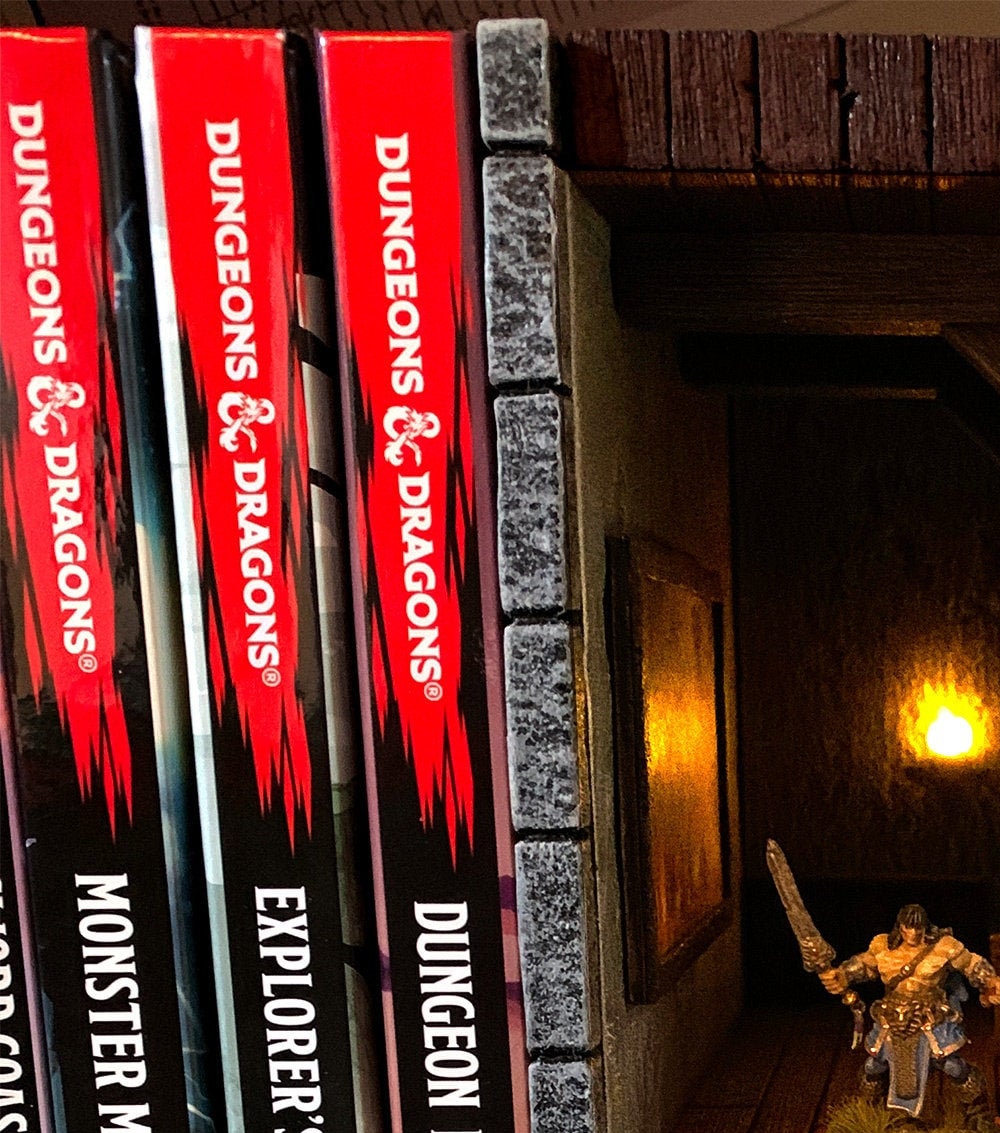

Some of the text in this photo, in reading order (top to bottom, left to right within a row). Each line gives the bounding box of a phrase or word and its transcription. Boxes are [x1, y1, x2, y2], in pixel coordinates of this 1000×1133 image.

[8, 101, 67, 366] DUNGEONS
[205, 117, 258, 381] DUNGEONS
[375, 132, 425, 394] DUNGEONS
[75, 873, 147, 1089] MONSTER
[414, 901, 480, 1109] DUNGEON
